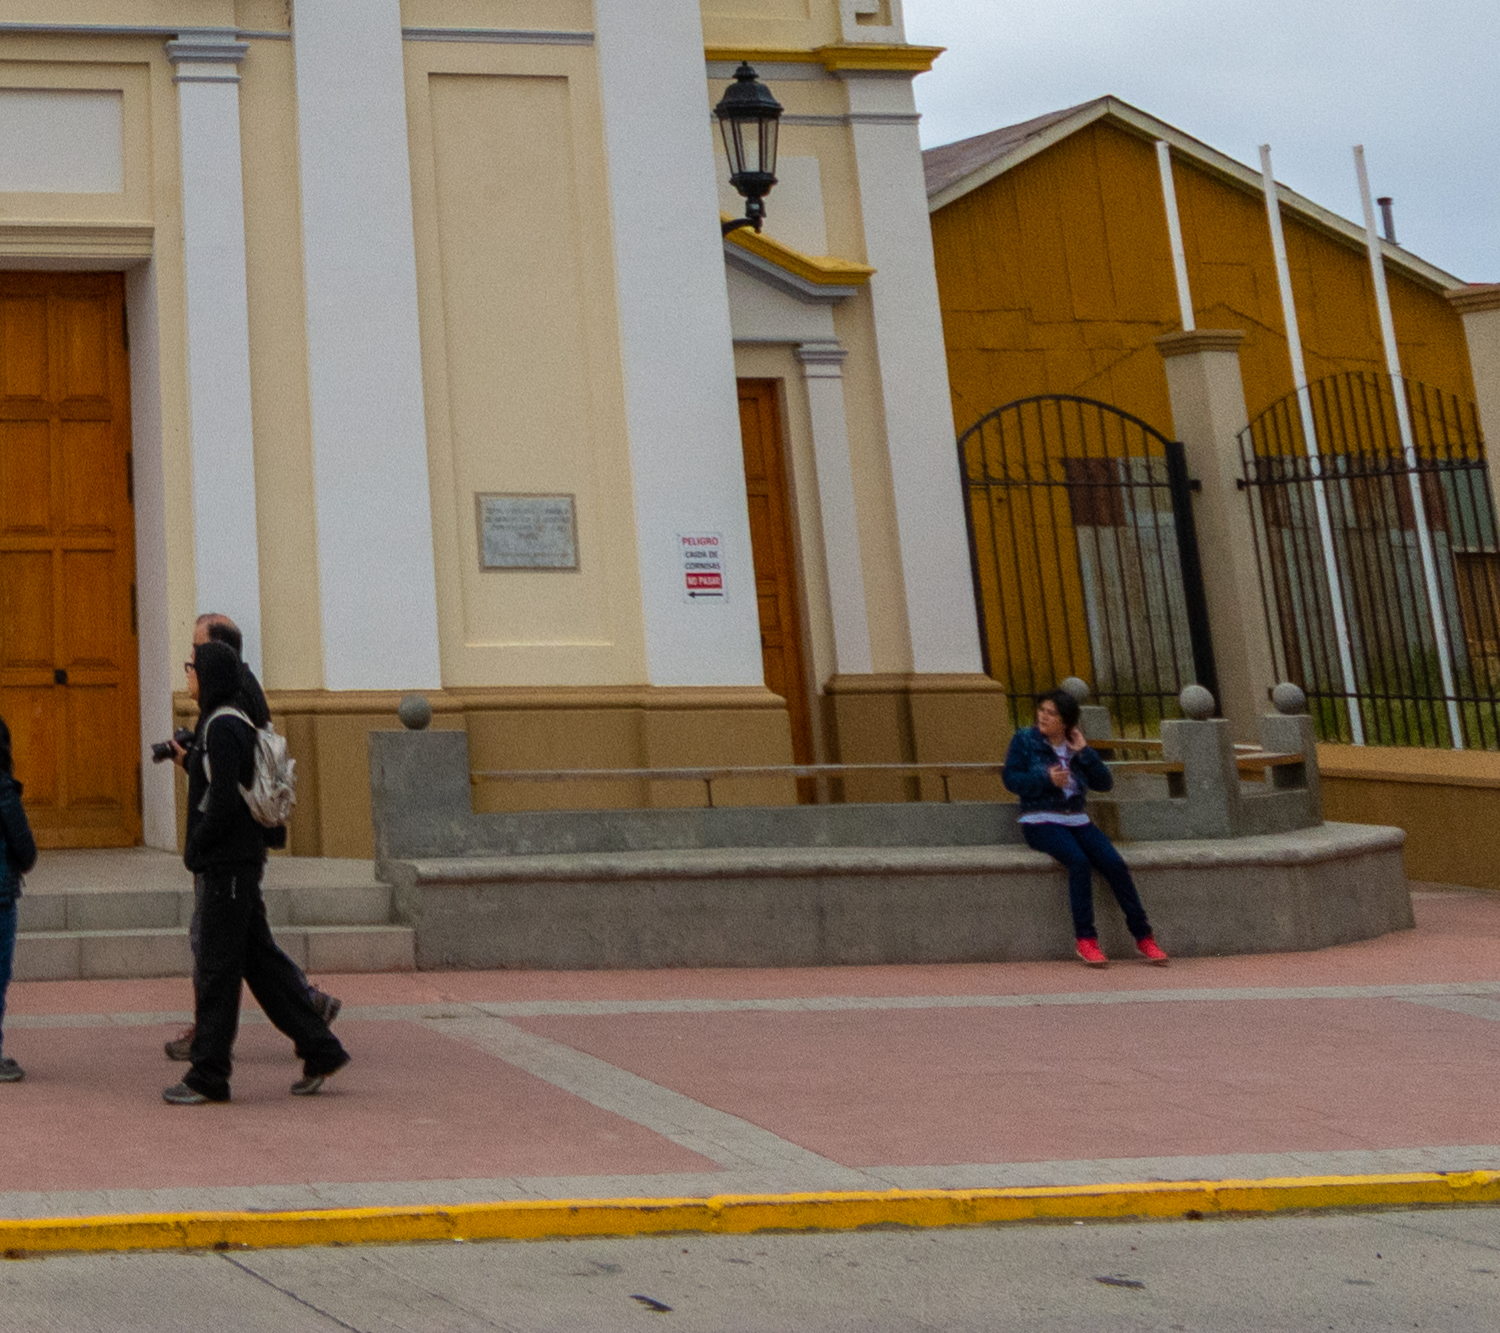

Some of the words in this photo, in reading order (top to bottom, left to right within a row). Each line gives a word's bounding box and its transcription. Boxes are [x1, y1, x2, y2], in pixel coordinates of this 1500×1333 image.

[682, 537, 719, 546] PELIGRO
[709, 551, 719, 559] DE
[685, 563, 721, 571] CORNISAS
[687, 576, 697, 586] NO
[698, 576, 721, 586] PASAR
